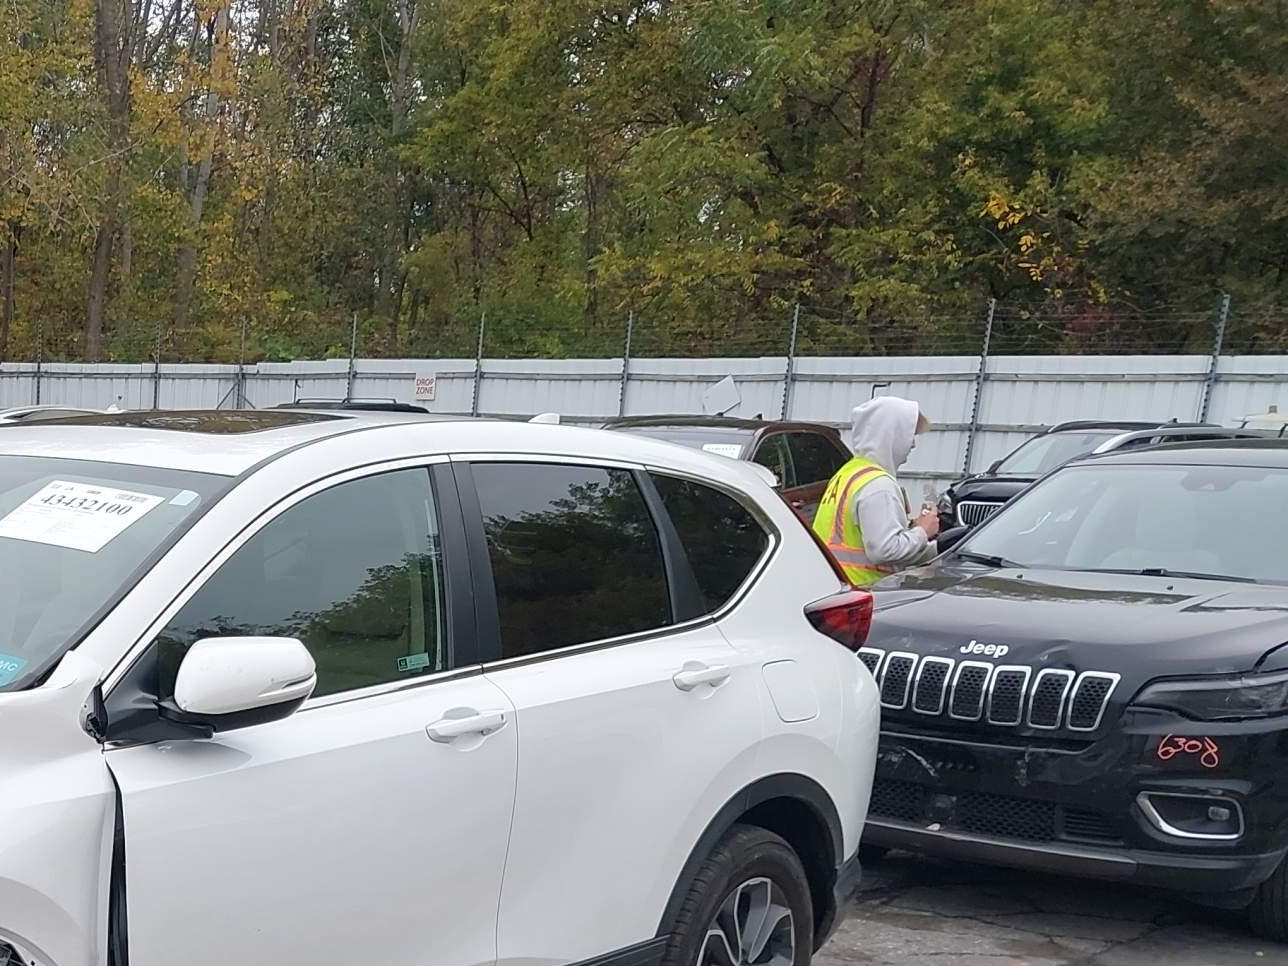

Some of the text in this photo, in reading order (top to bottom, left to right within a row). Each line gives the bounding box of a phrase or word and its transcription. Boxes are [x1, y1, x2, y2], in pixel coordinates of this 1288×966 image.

[415, 386, 433, 395] ZONE
[40, 493, 133, 516] 43432100
[959, 639, 1009, 659] Jeep
[1157, 732, 1219, 768] 6308
